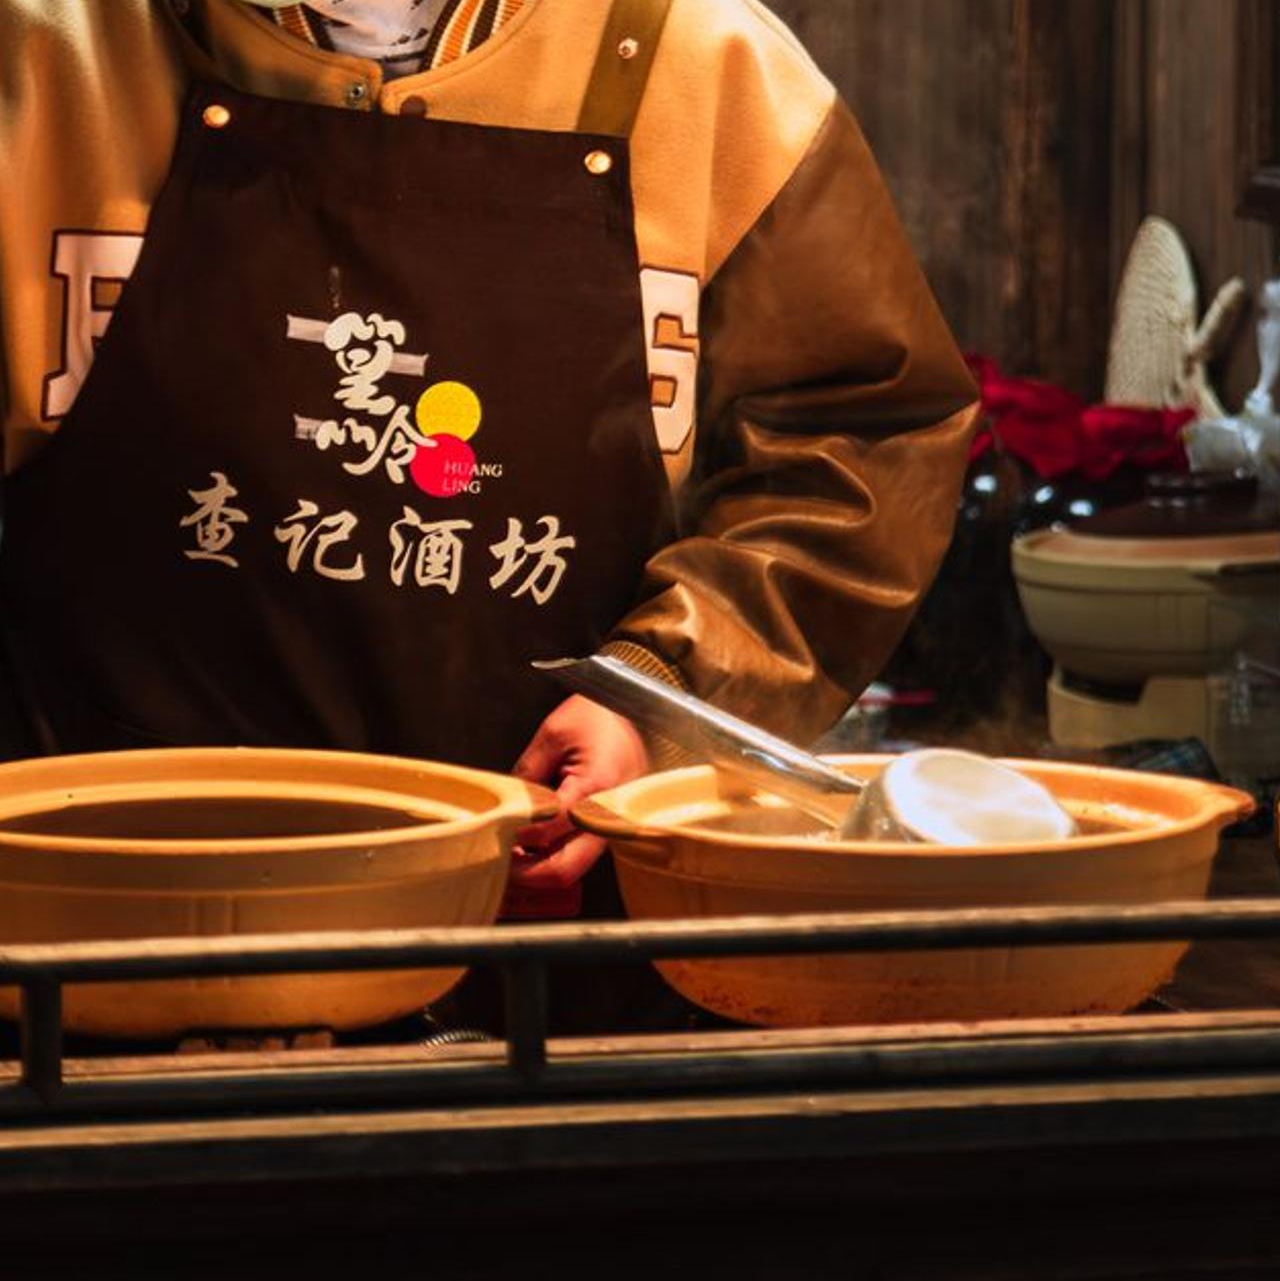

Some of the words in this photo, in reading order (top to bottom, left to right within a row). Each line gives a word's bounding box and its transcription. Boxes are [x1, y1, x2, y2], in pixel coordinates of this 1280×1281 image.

[444, 460, 503, 478] HUANG
[442, 478, 481, 494] LING
[179, 471, 577, 606] 查记酒坊
